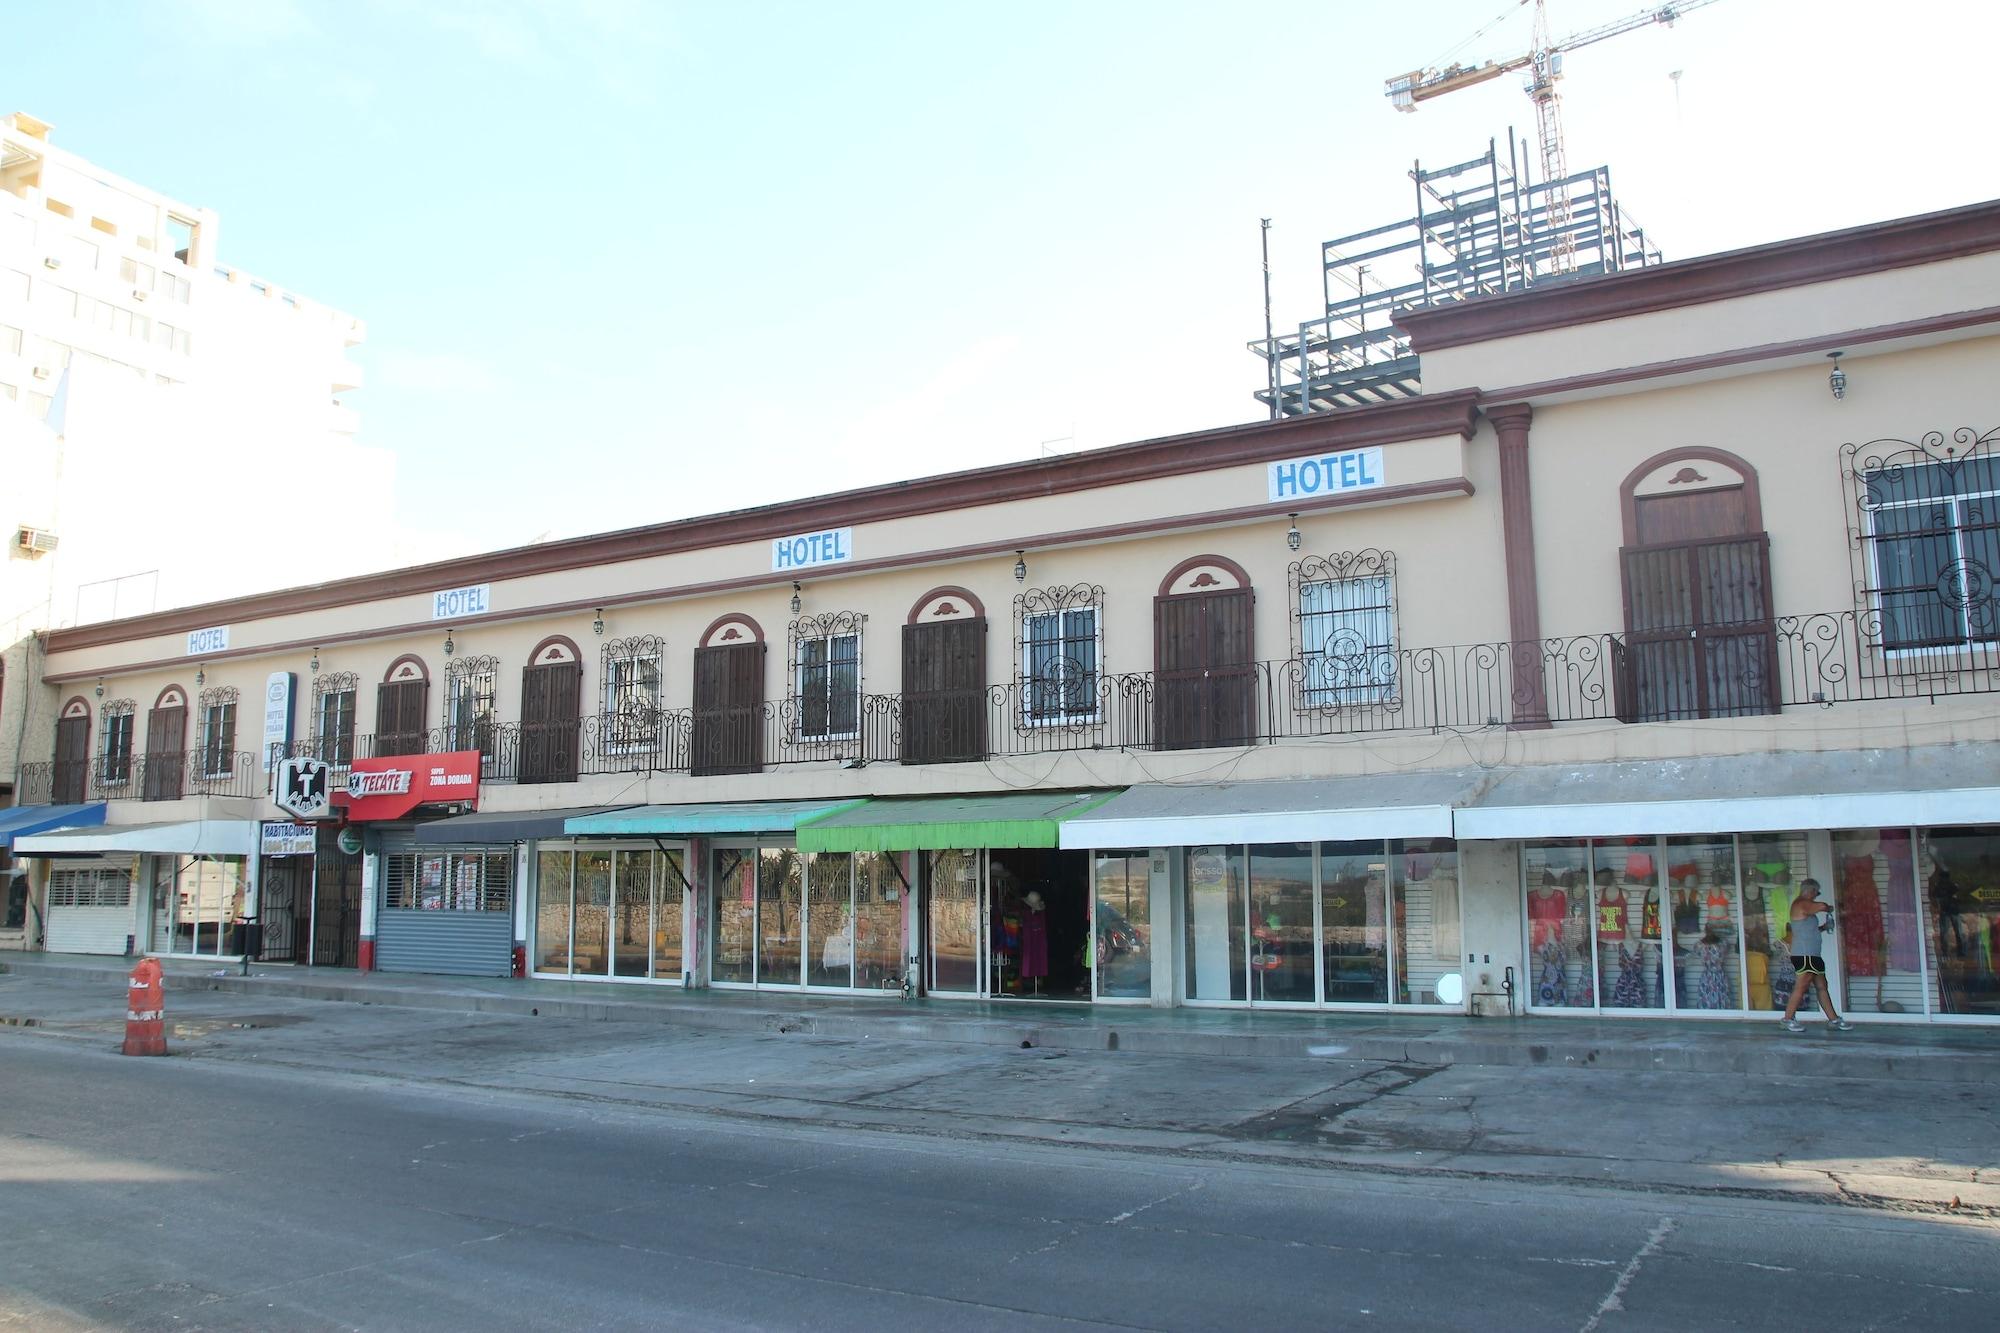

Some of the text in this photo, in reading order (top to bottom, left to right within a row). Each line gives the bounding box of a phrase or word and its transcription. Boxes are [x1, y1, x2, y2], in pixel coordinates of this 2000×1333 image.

[1276, 453, 1375, 497] HOTEL
[777, 532, 845, 568] HOTEL
[437, 588, 484, 617] HOTEL
[190, 628, 225, 653] HOTEL
[363, 773, 402, 792] TECATE
[429, 774, 472, 786] ZONA DORADA
[430, 767, 445, 775] SUPER
